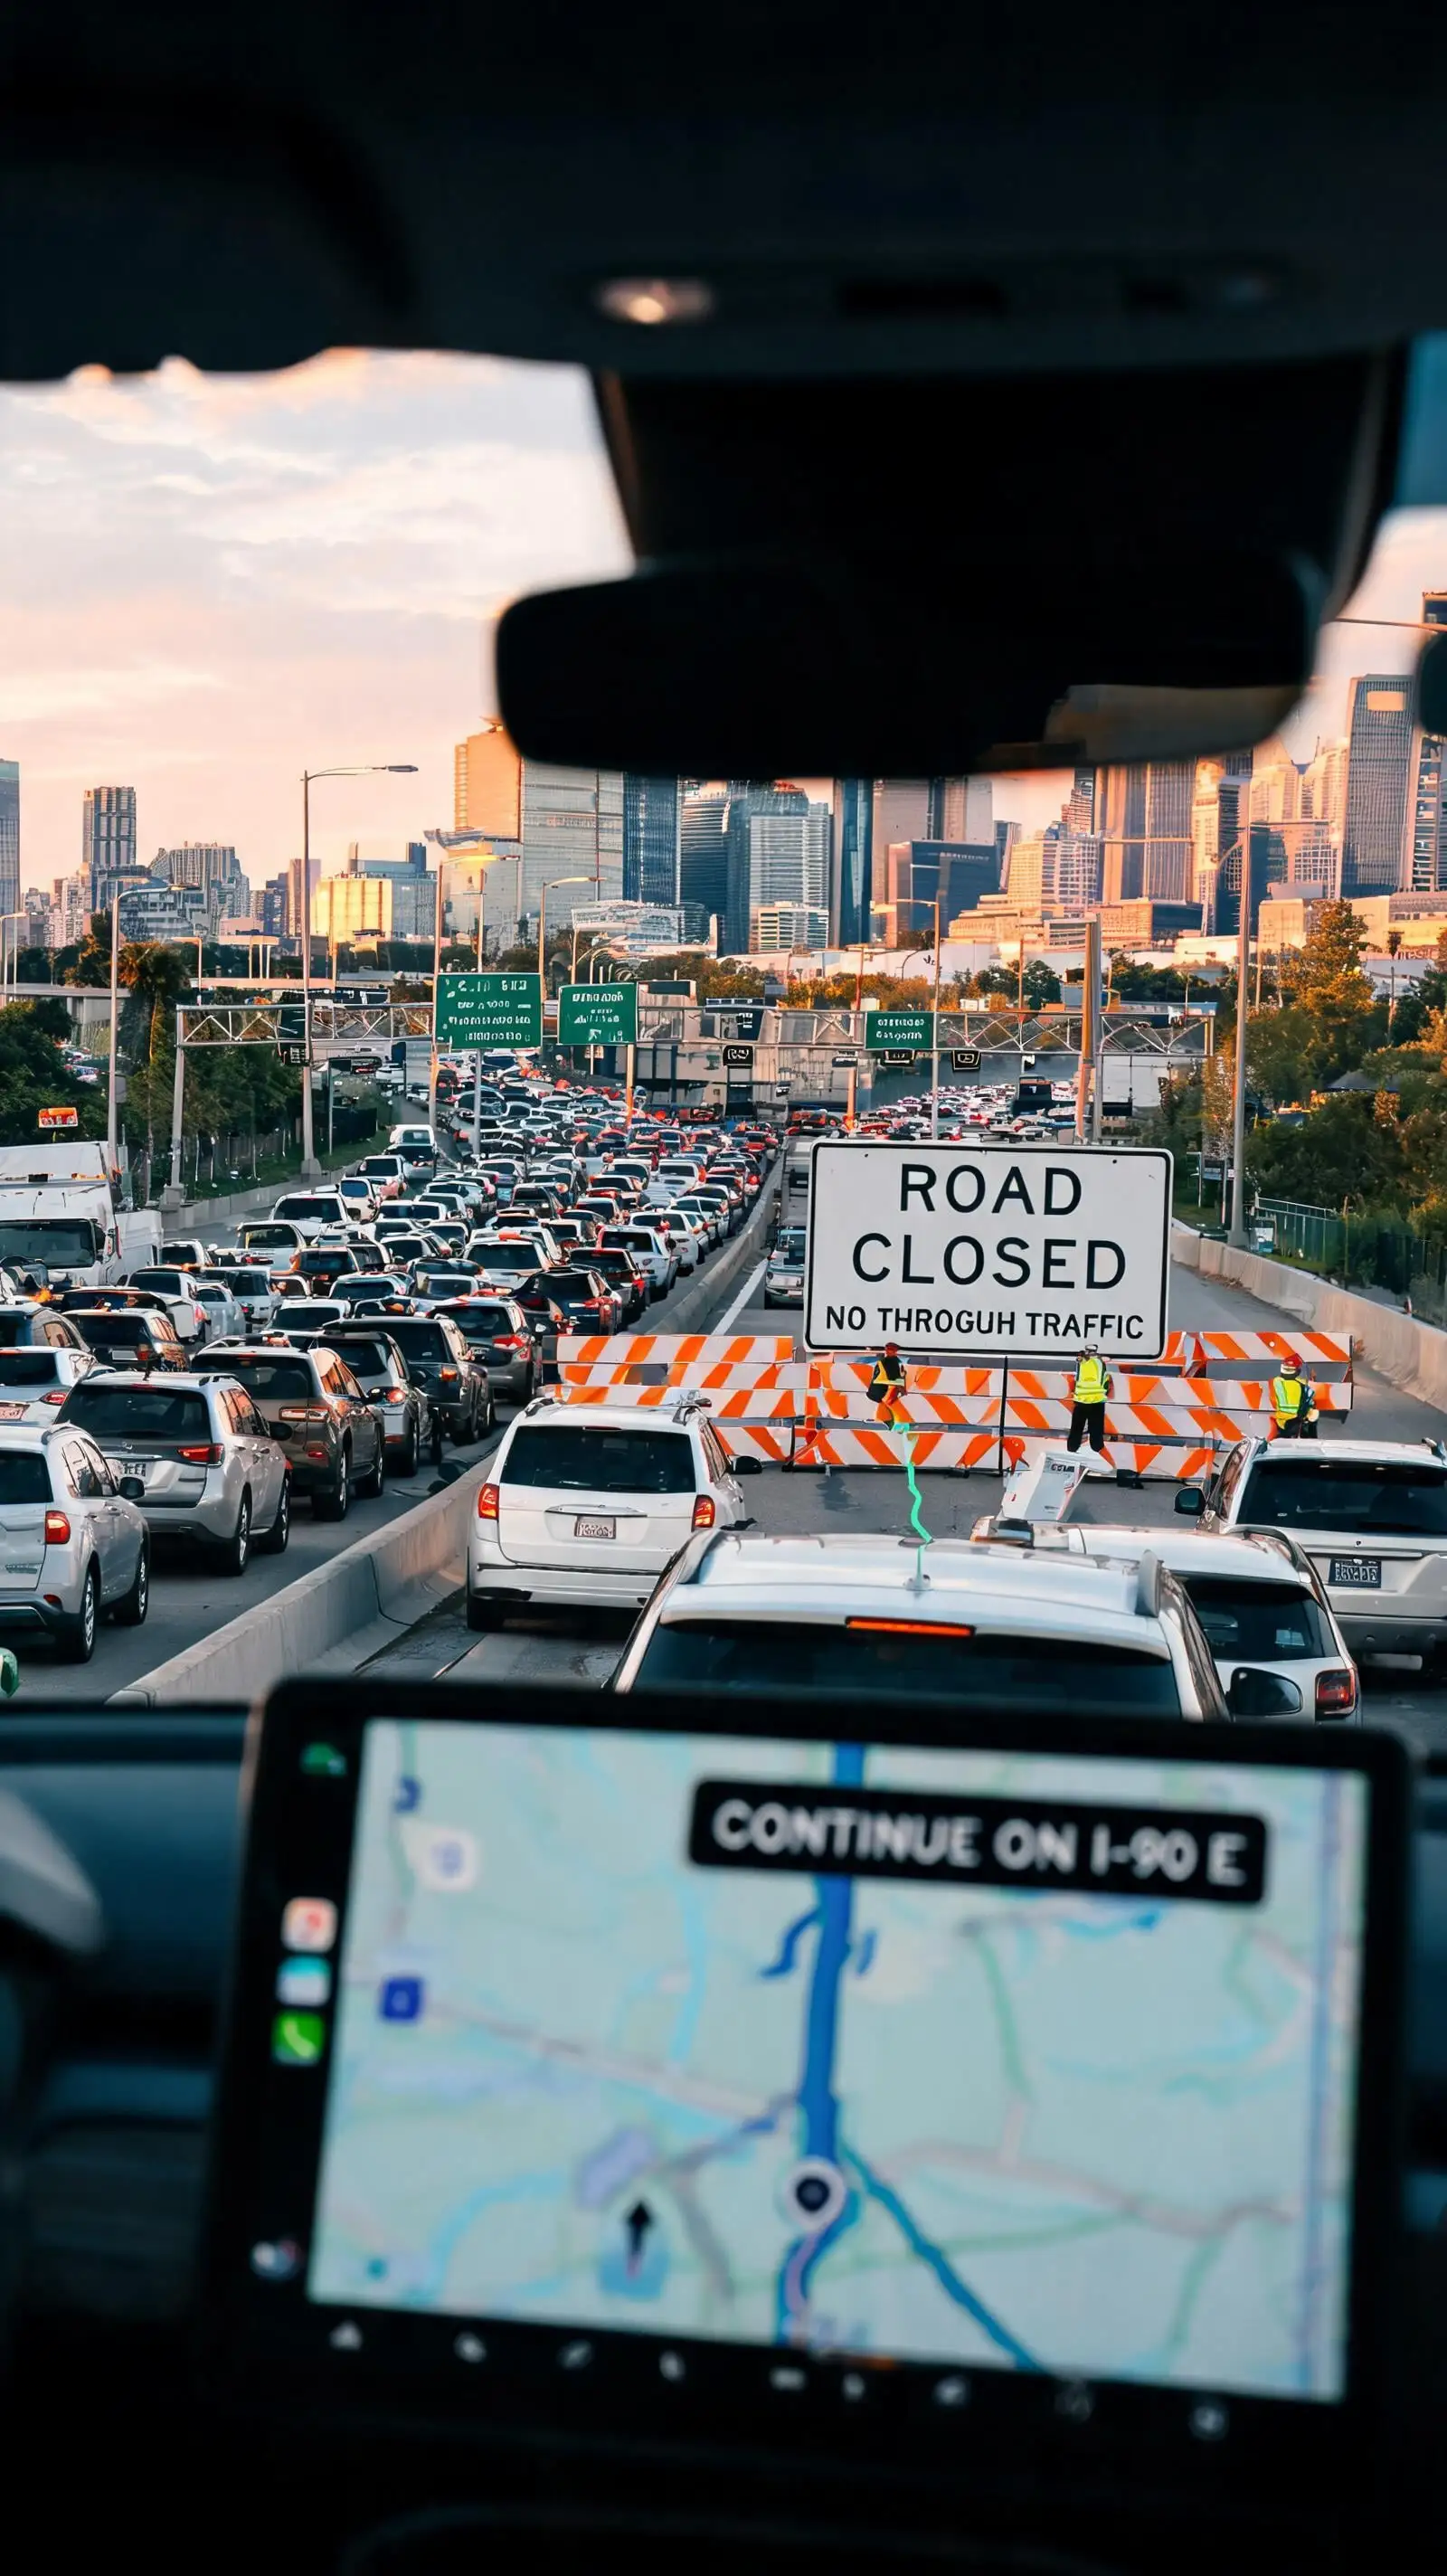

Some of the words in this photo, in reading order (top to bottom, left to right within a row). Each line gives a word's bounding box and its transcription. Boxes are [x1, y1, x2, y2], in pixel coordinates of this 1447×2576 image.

[900, 1163, 1082, 1216] ROAD
[852, 1233, 1126, 1290] CLOSED
[826, 1305, 866, 1331] NO
[877, 1307, 1015, 1335] THROGUH
[1026, 1312, 1144, 1340] TRAFFIC
[713, 1799, 982, 1868] CONTINUE
[993, 1817, 1079, 1874] ON
[1089, 1823, 1199, 1882] I-90
[1206, 1831, 1248, 1887] E
